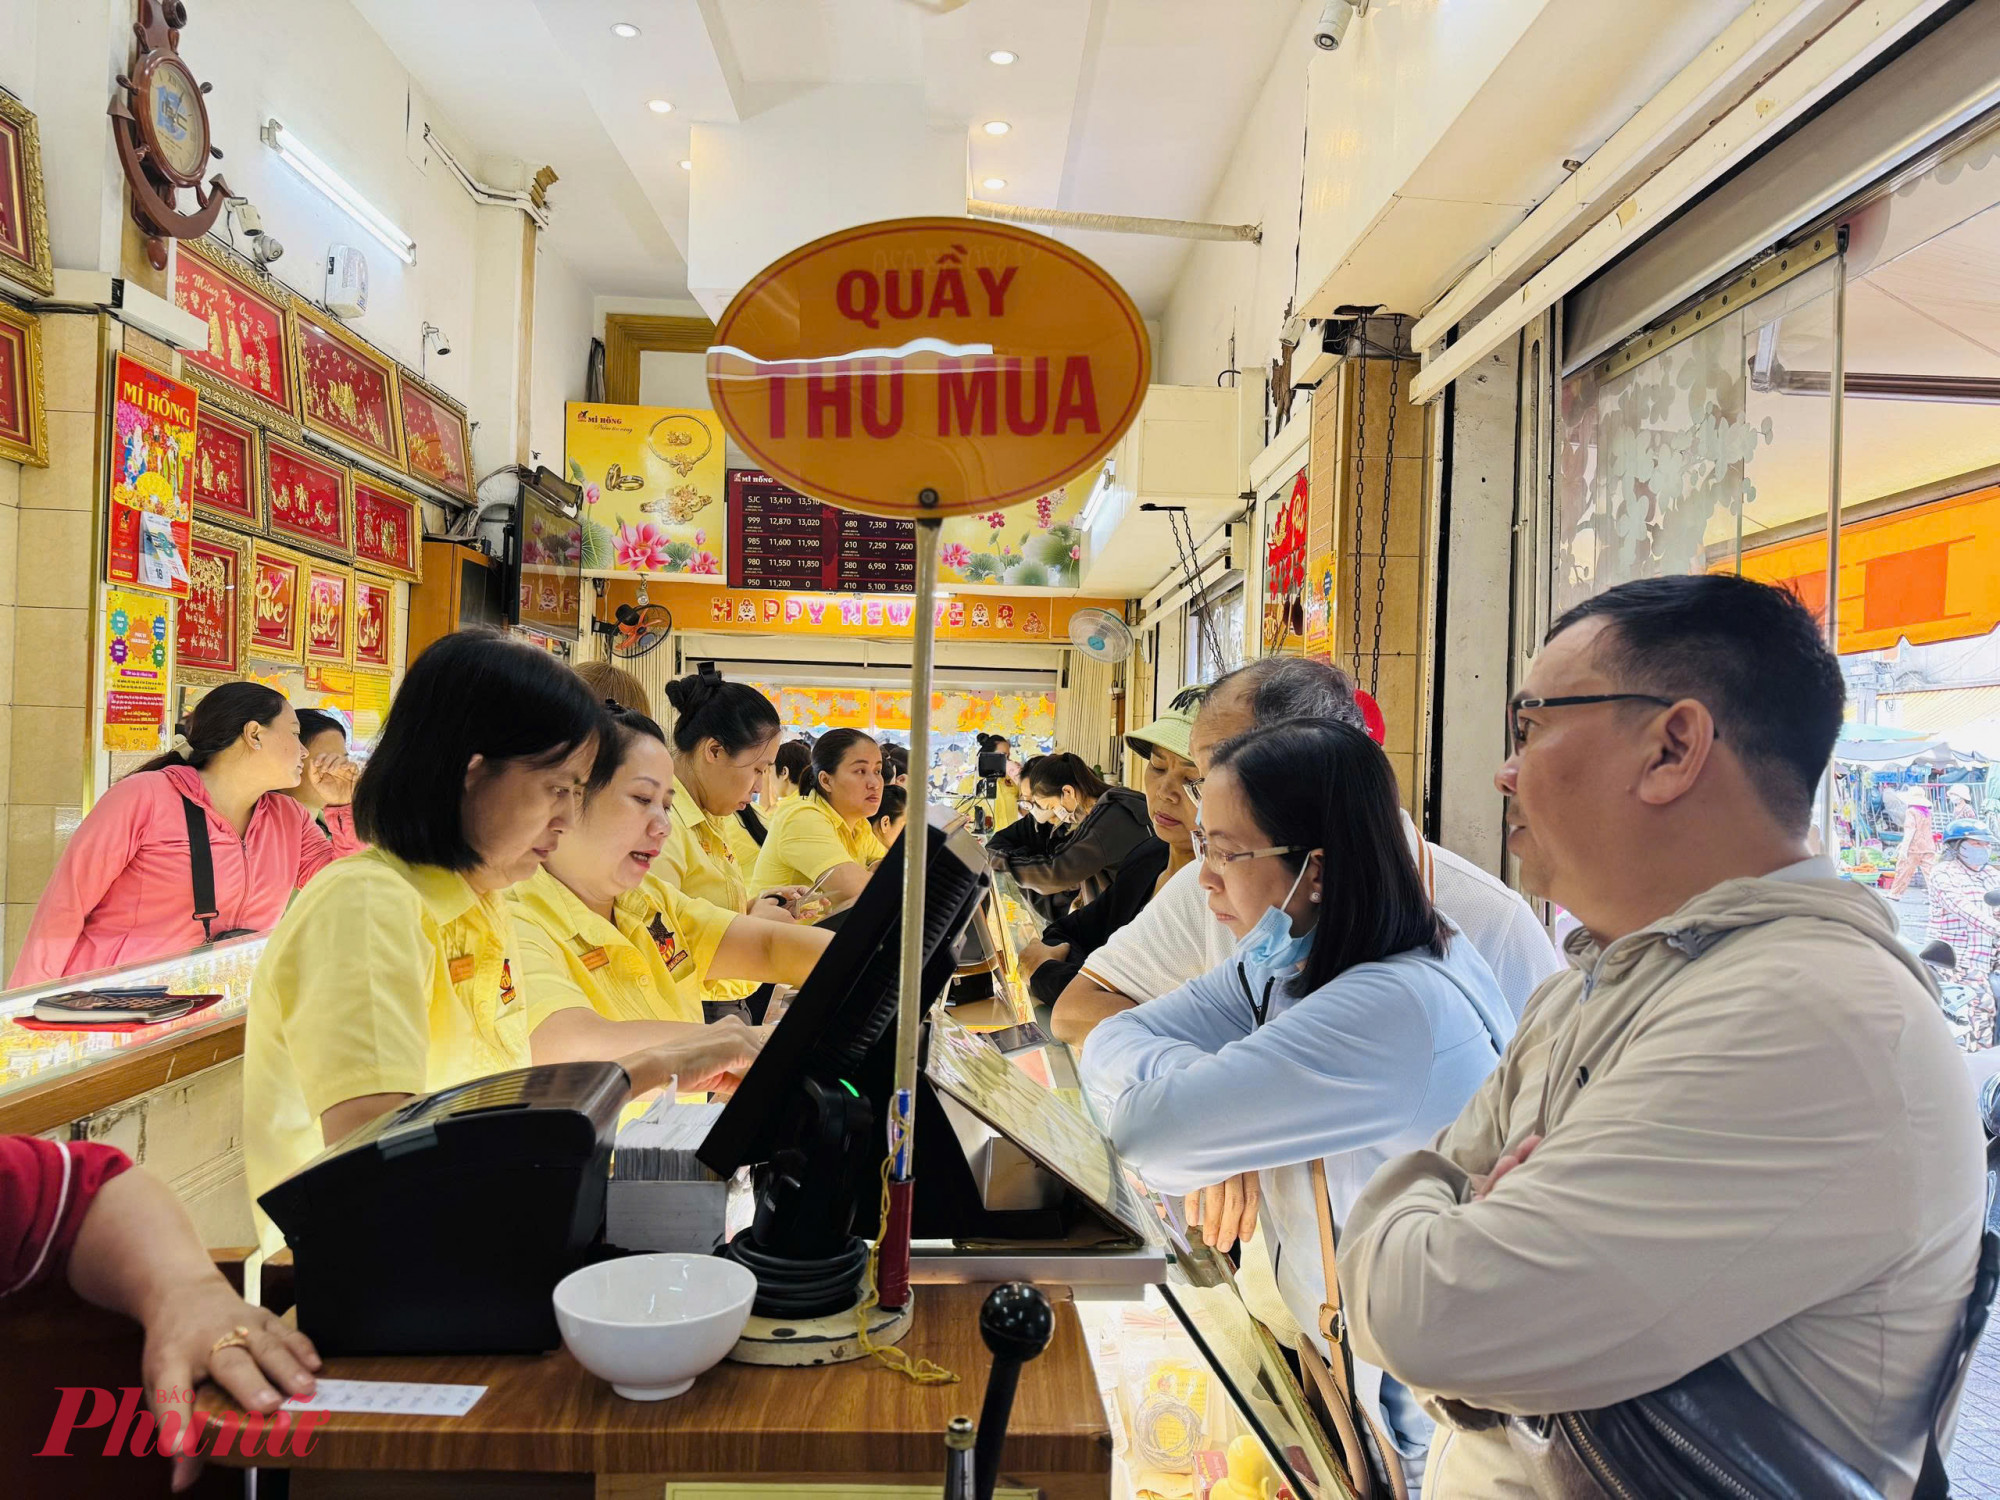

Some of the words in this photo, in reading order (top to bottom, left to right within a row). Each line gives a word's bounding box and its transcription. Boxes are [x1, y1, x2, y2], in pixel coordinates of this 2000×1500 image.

[836, 244, 1019, 329] QUẦY
[755, 356, 903, 439] THU
[937, 355, 1102, 437] MUA
[147, 389, 191, 427] HỒNG
[769, 496, 792, 504] 13,410
[798, 497, 820, 506] 13,510
[769, 517, 792, 525] 12,870
[798, 518, 820, 526] 13,020
[844, 520, 858, 528] 680
[868, 521, 887, 529] 7,350
[895, 522, 914, 530] 7,700
[747, 537, 760, 545] 985
[769, 538, 792, 546] 11,600
[797, 539, 820, 548] 11,900
[868, 542, 887, 550] 7,250
[895, 543, 914, 551] 7,600
[768, 559, 791, 567] 11,550
[797, 560, 820, 568] 11,850
[867, 562, 887, 570] 6,950
[895, 563, 913, 571] 7,300
[768, 579, 791, 588] 11,200
[867, 583, 886, 591] 5,100
[894, 584, 913, 592] 5,450
[711, 598, 825, 625] HAPPY
[838, 599, 912, 626] NEW
